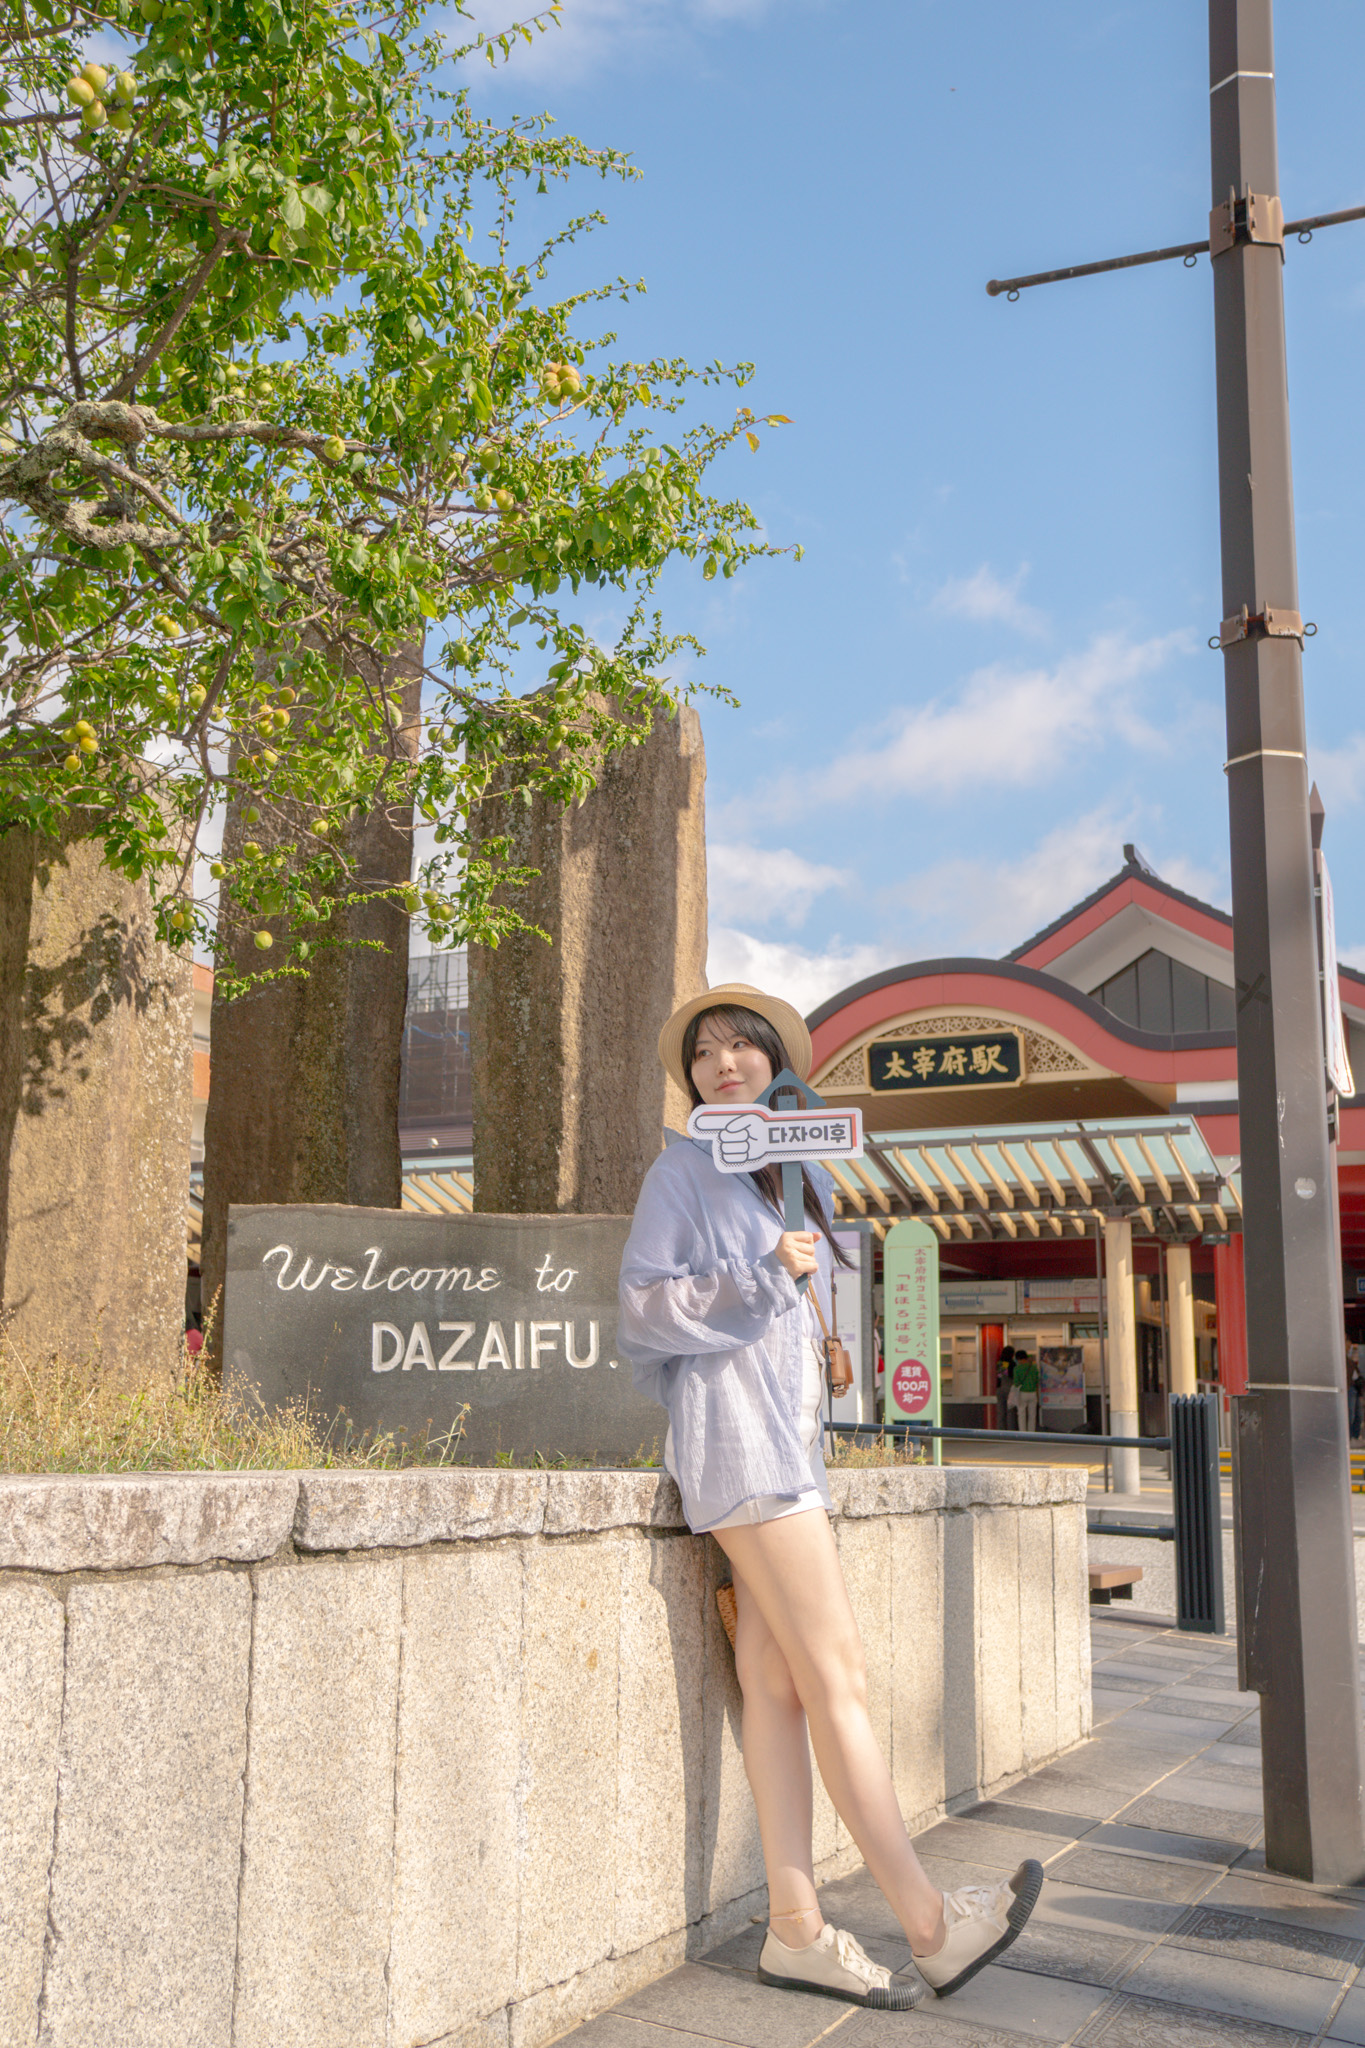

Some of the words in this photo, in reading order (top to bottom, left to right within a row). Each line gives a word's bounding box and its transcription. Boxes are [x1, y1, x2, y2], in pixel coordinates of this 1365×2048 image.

[882, 1045, 1008, 1081] 太宰府駅
[768, 1123, 847, 1144] 다자이후
[262, 1243, 501, 1291] Welcome
[534, 1253, 579, 1292] to
[896, 1380, 928, 1391] 100円
[902, 1392, 924, 1404] 均一
